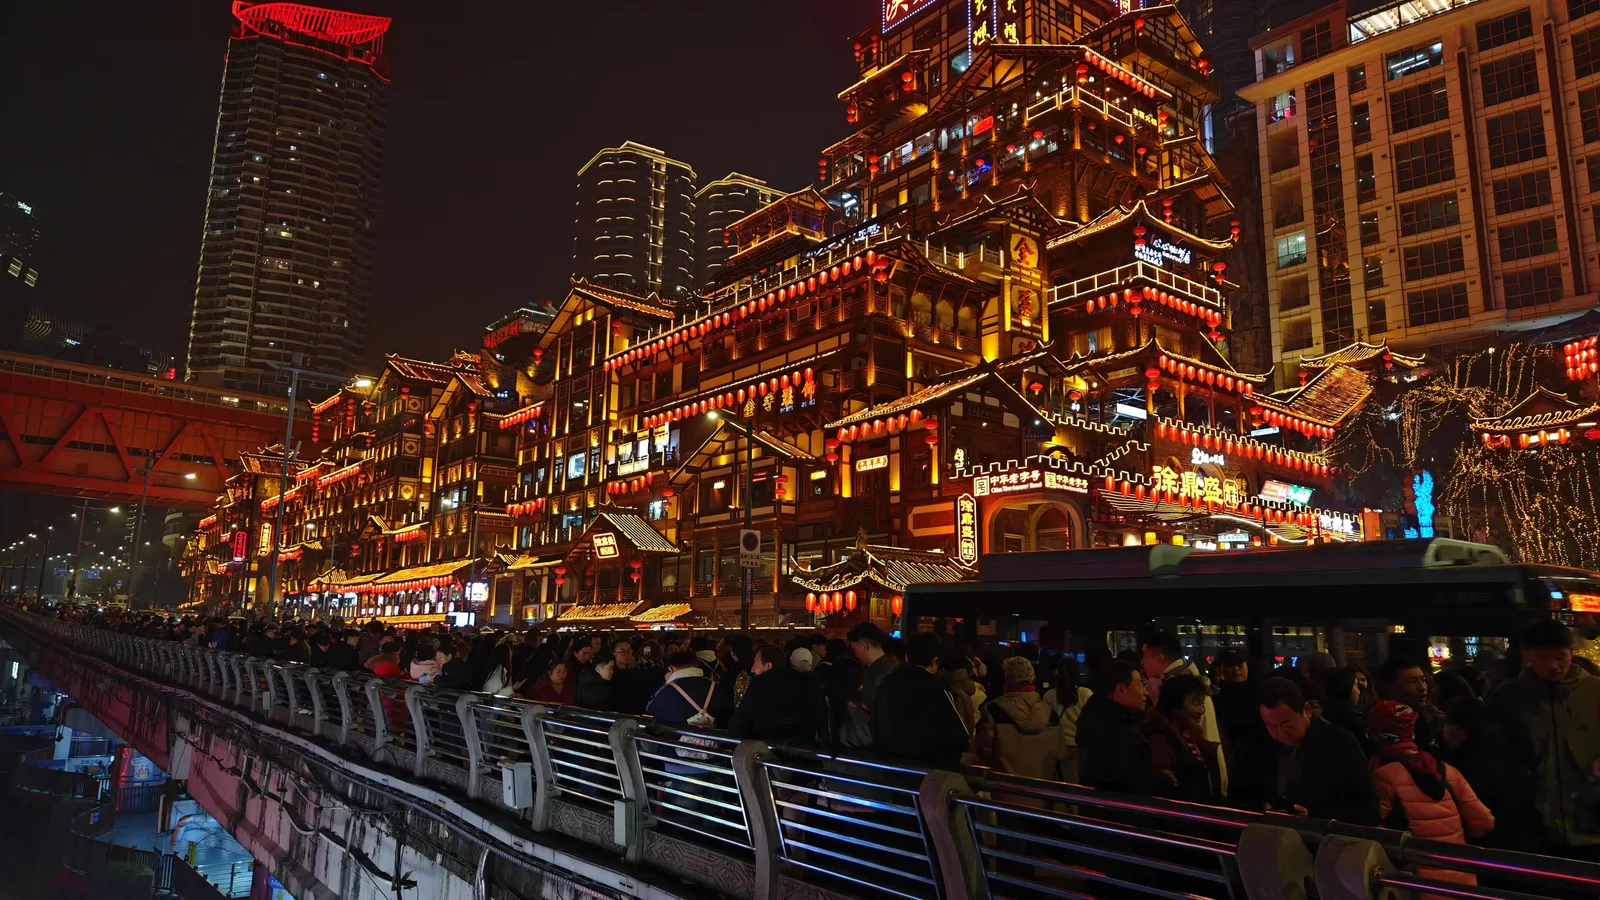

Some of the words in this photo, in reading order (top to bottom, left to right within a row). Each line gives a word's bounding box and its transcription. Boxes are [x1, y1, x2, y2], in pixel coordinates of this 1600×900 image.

[990, 470, 1041, 486] 中华老字号
[1152, 465, 1224, 505] 徐鼎盛
